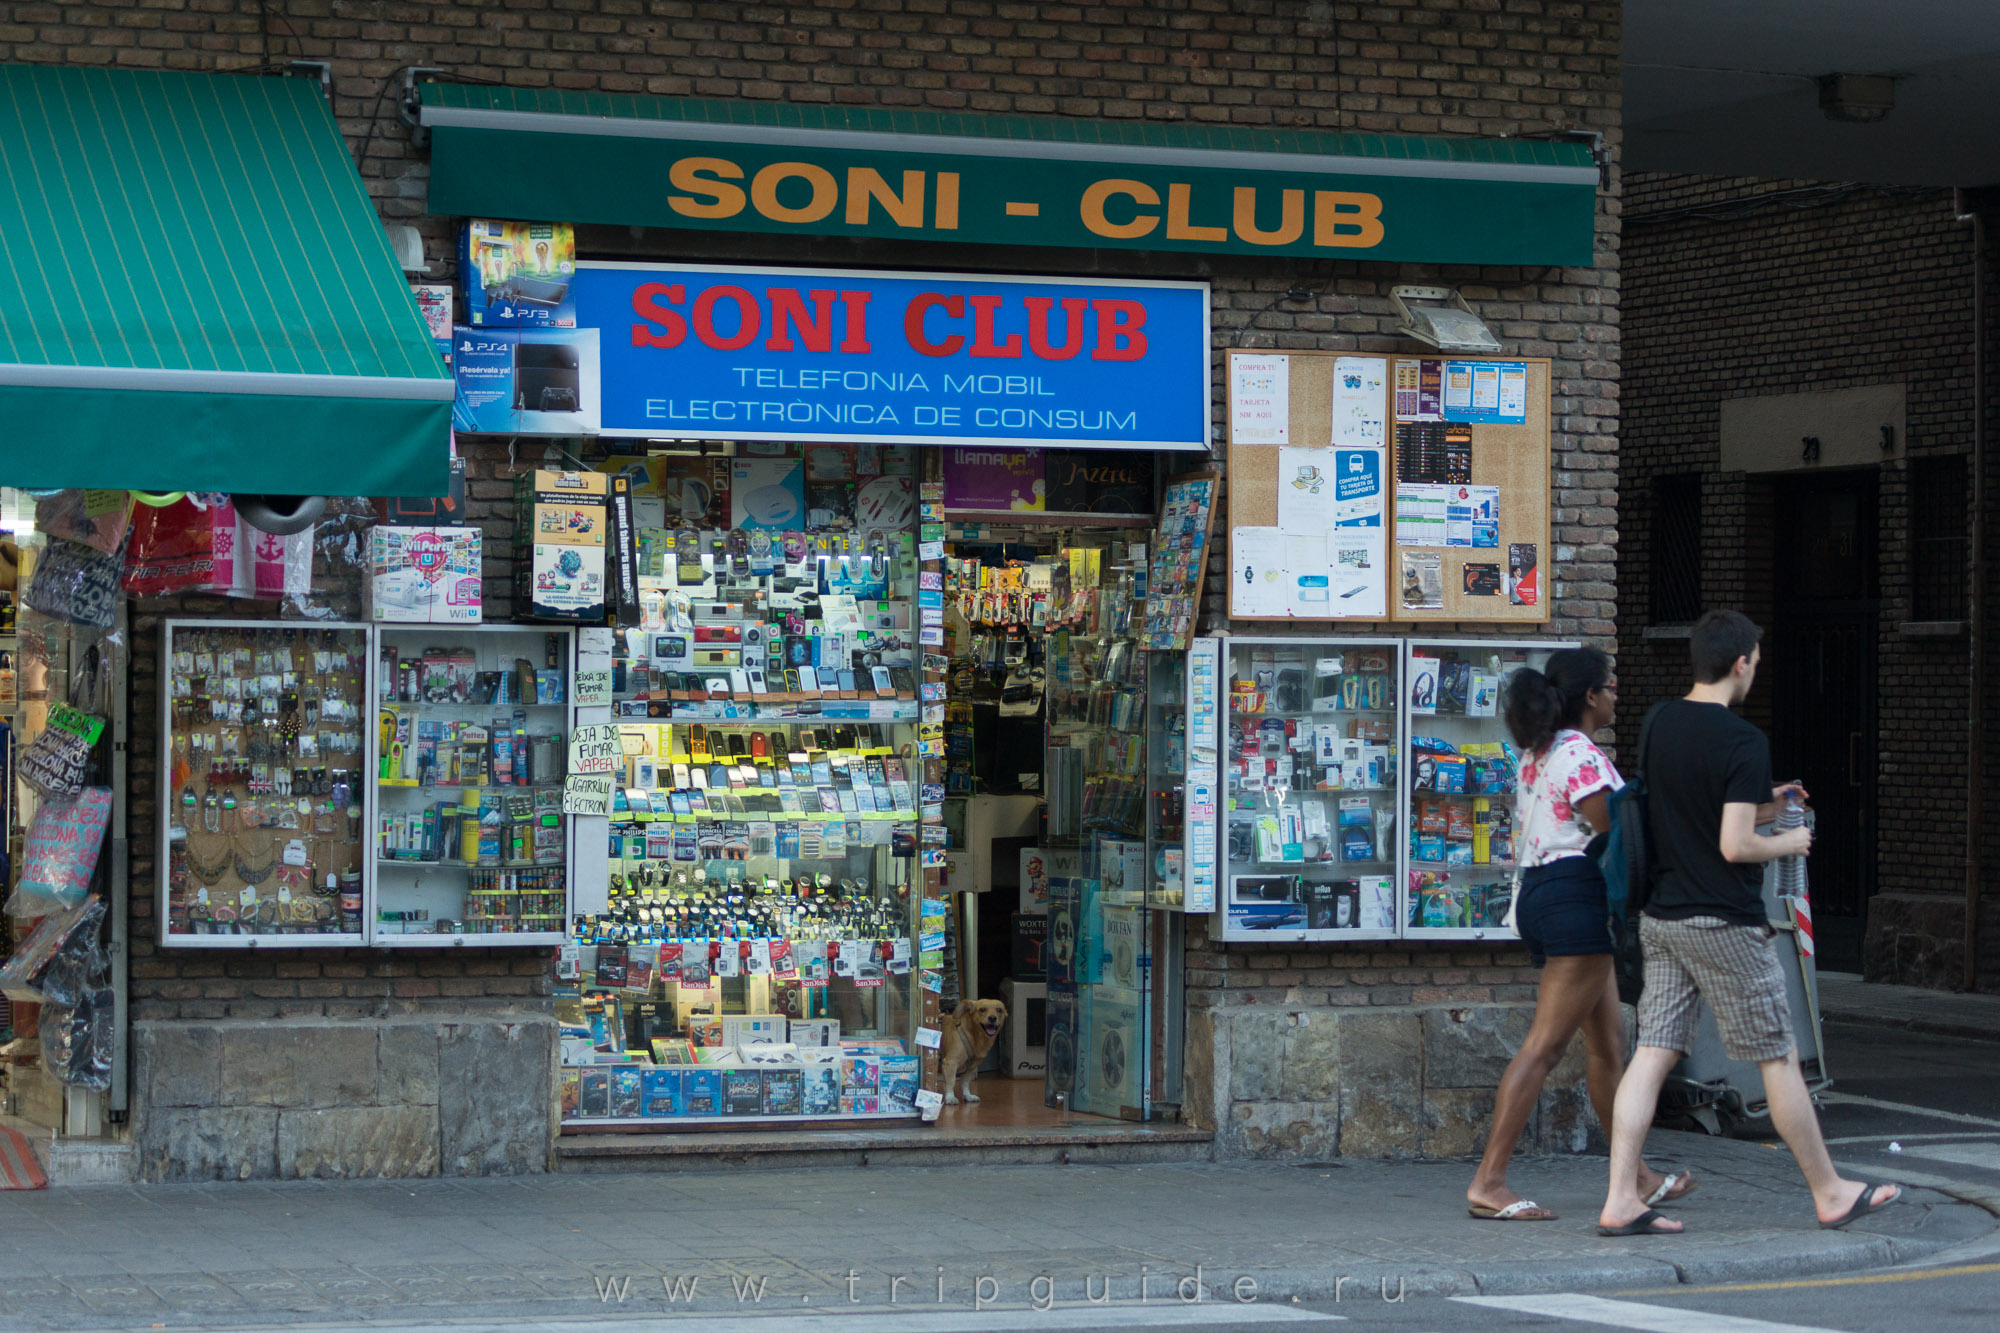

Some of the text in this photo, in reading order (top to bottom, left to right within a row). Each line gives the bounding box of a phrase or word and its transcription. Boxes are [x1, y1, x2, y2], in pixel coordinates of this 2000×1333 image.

[667, 156, 960, 230] SONI
[1080, 178, 1385, 249] CLUB
[518, 309, 549, 319] PS3
[632, 282, 1149, 362] SONI CLUB
[477, 343, 508, 351] PS4
[732, 366, 1056, 397] TELEFONIA MOBIL
[646, 396, 1137, 431] ELECTRÒNICA DE CONSUM
[1446, 423, 1472, 434] ahora
[1339, 476, 1359, 485] COMPRA
[1348, 481, 1366, 489] TARJETA
[1341, 485, 1375, 497] TRANSPORTE
[401, 540, 454, 554] Wii Party
[449, 609, 467, 618] Wii
[596, 671, 608, 681] DE
[462, 731, 485, 739] Pattex
[571, 725, 618, 744] DEJA DE
[682, 981, 710, 990] SanDisk
[801, 979, 828, 988] SanDisk
[855, 979, 882, 987] SanDisk
